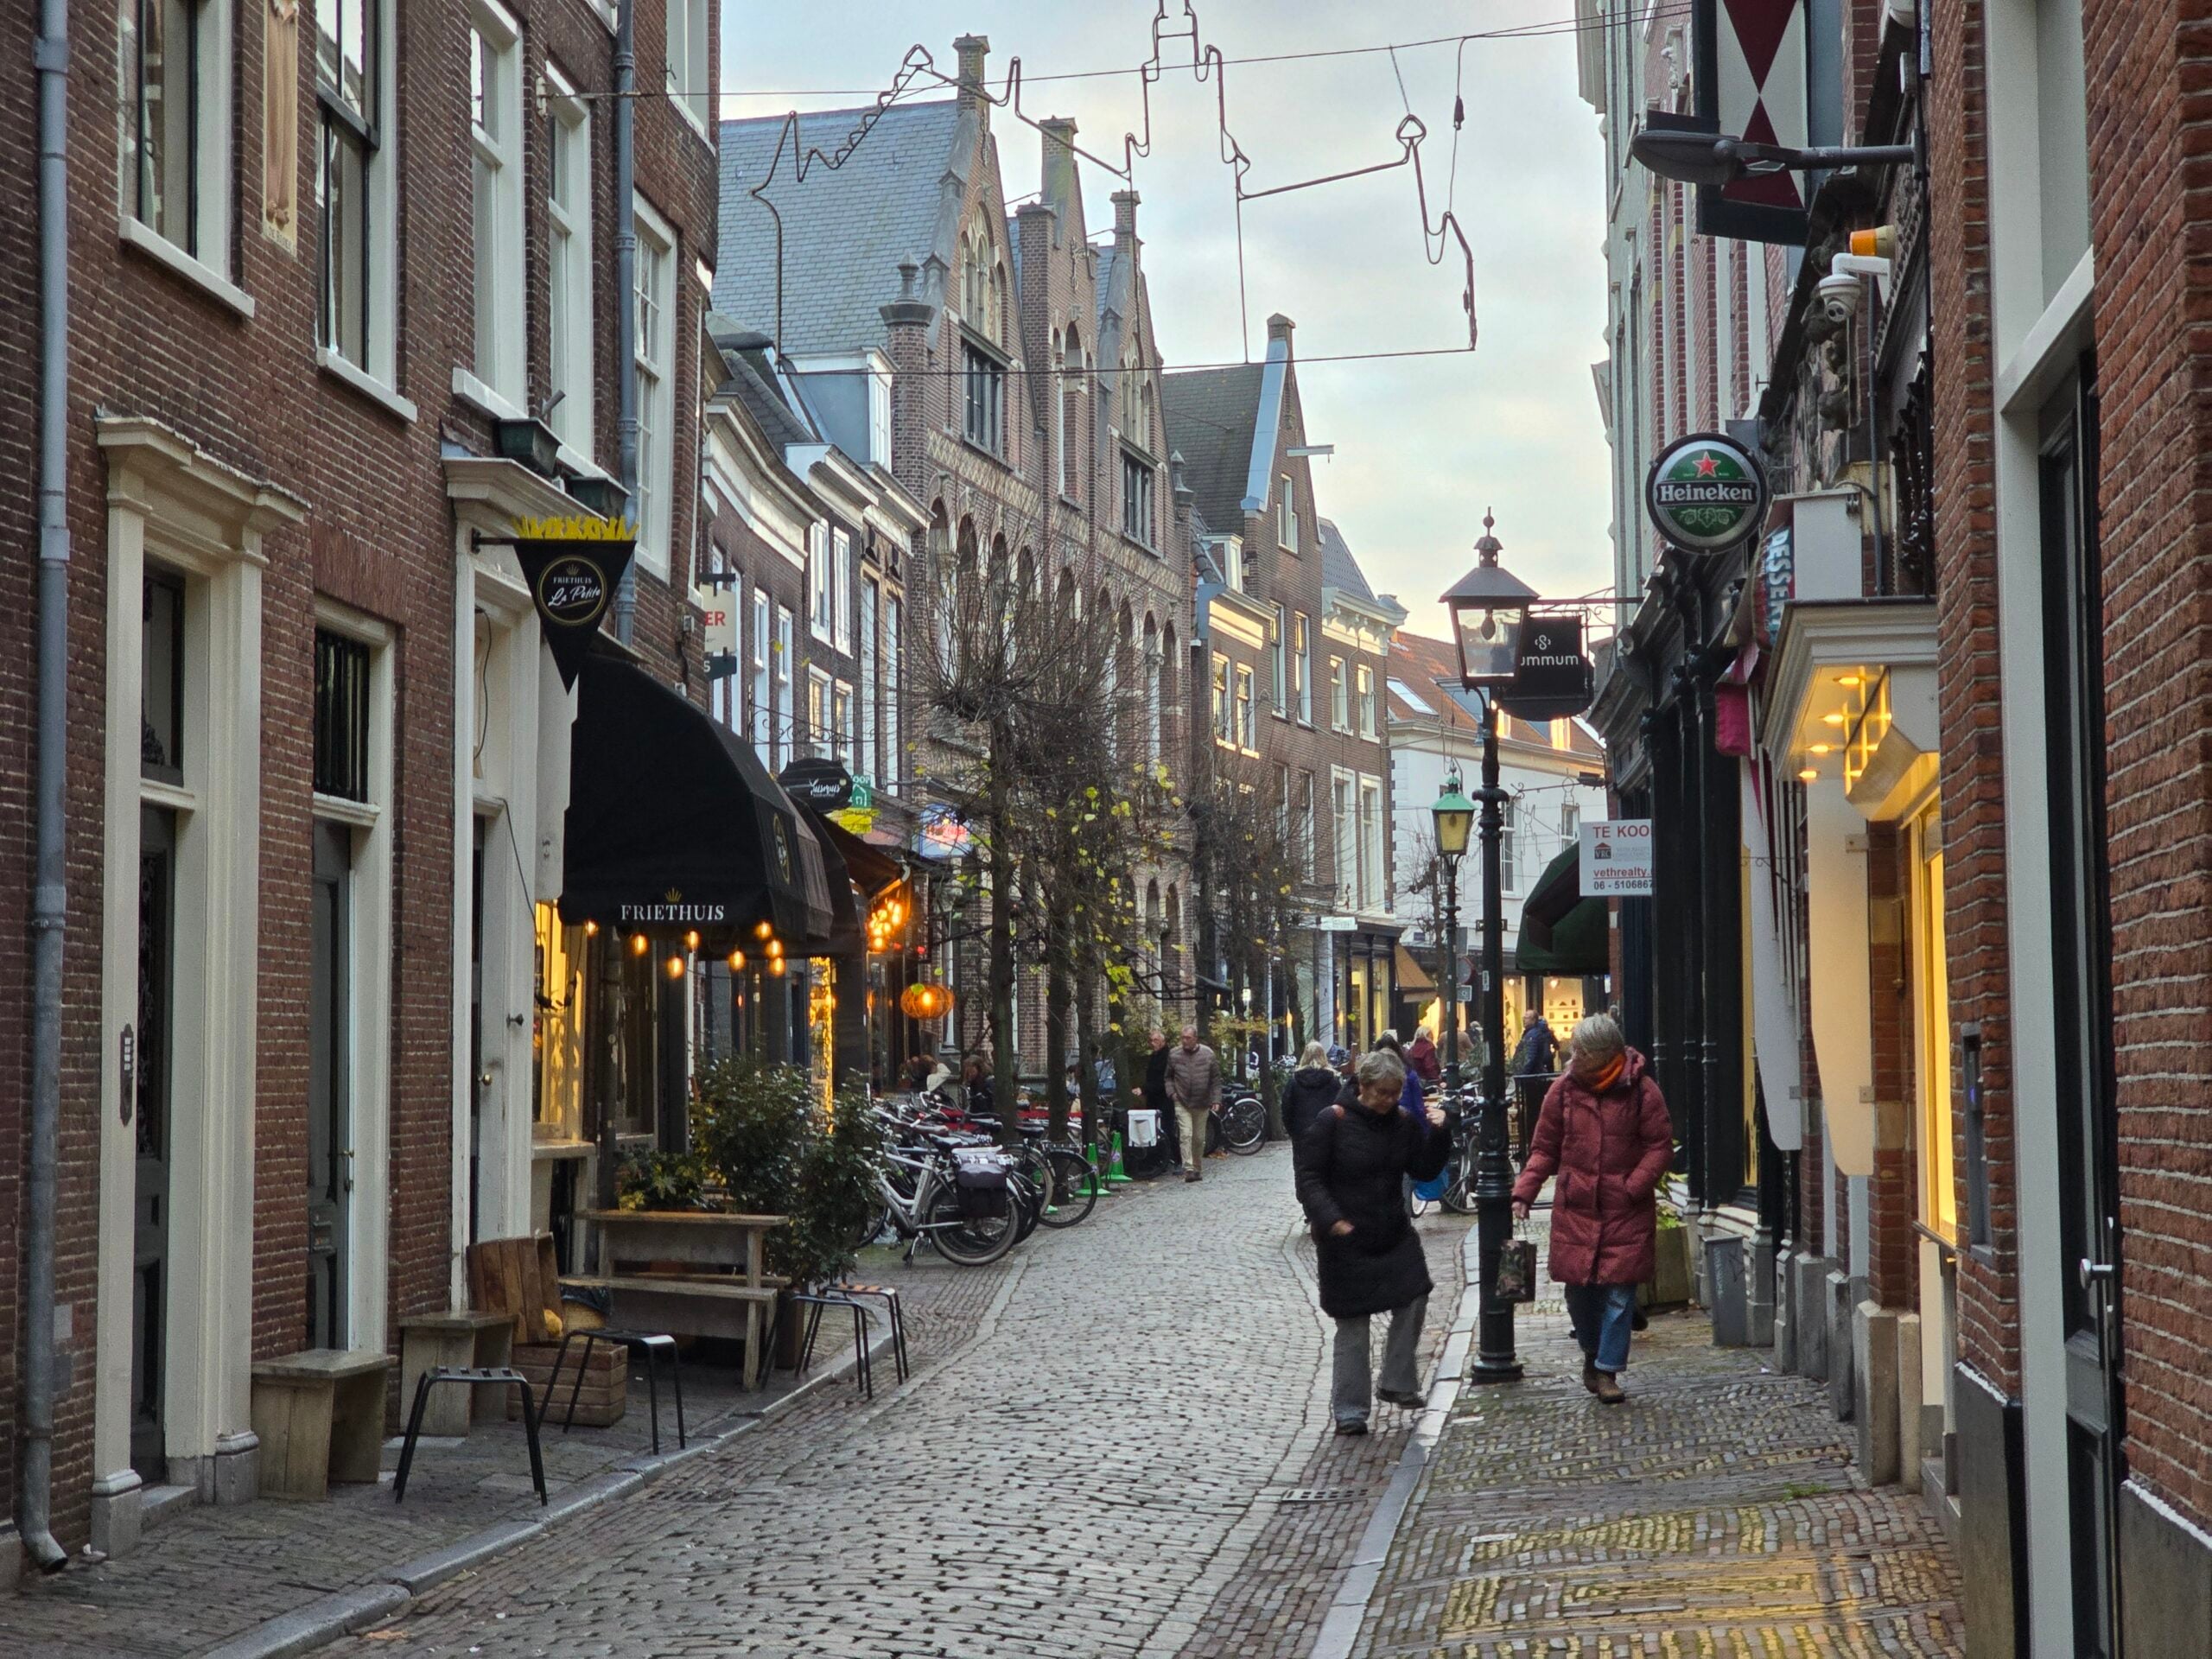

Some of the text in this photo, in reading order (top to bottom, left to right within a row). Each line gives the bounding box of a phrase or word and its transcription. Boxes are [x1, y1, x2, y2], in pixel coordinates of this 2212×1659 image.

[1660, 484, 1753, 501] Heineken
[705, 610, 726, 626] ER
[1592, 825, 1649, 838] TE KOO
[1593, 880, 1605, 890] 06
[620, 904, 725, 920] FRIETHUIS
